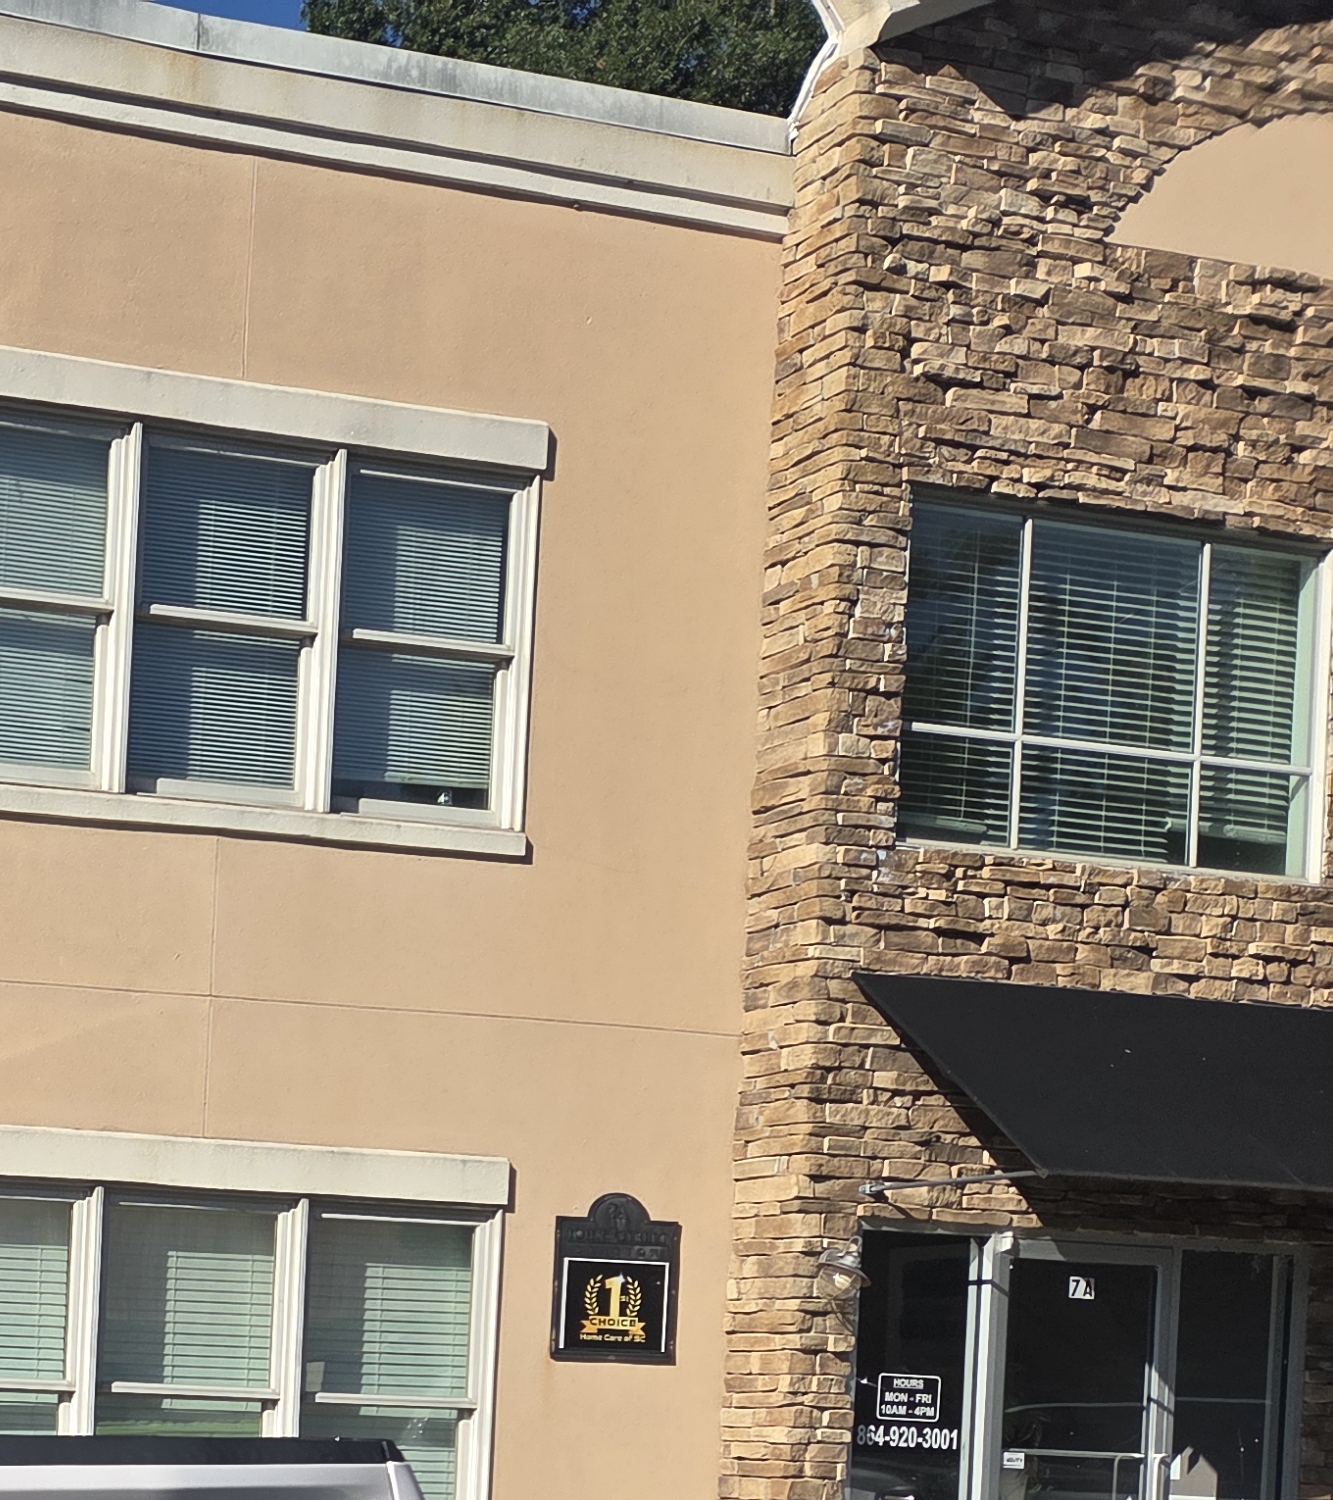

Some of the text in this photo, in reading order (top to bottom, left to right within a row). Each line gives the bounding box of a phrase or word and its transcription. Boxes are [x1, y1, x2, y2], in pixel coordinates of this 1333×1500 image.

[1071, 1279, 1093, 1297] 7A
[590, 1317, 637, 1327] CHOICE
[604, 1334, 622, 1342] Care
[893, 1378, 924, 1389] HOURS
[884, 1392, 908, 1402] MON
[915, 1394, 932, 1403] FRI
[881, 1404, 907, 1415] 10AM
[914, 1407, 934, 1416] 4PM
[857, 1425, 958, 1450] 864-920-3001
